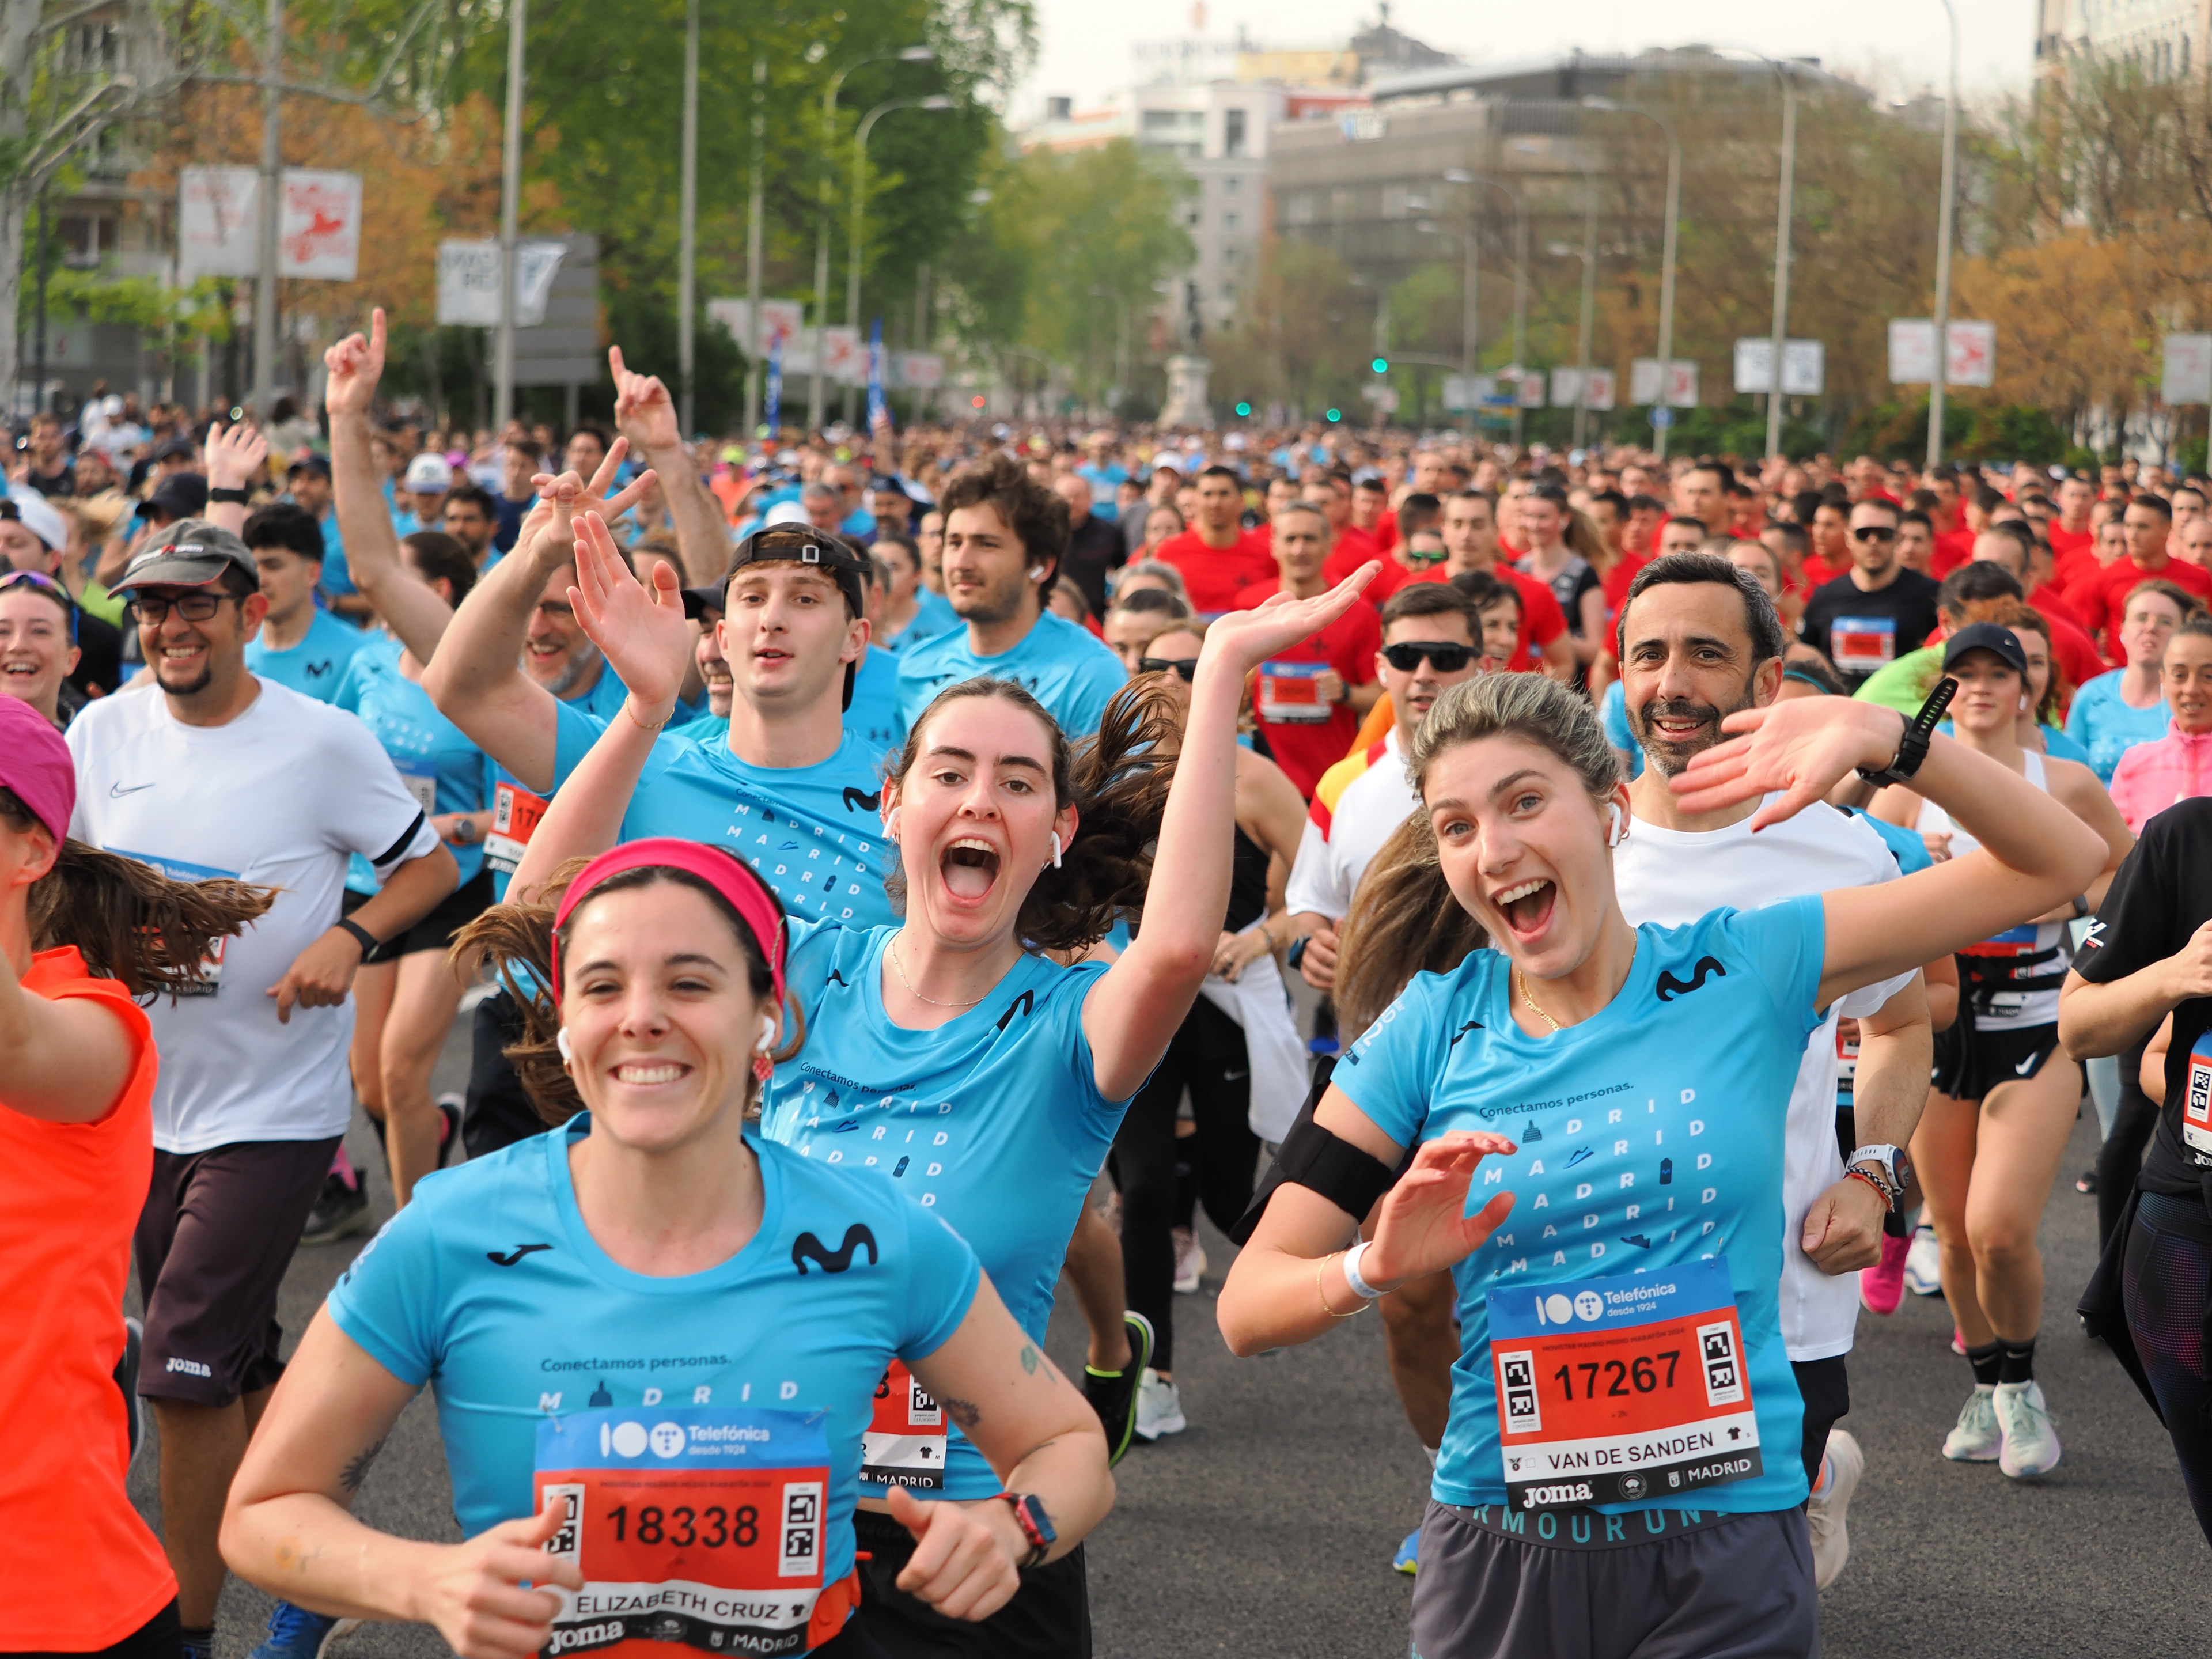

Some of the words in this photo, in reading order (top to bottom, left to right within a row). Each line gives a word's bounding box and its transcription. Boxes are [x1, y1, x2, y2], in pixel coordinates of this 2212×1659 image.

[800, 1062, 859, 1090] Conectamos
[1479, 1099, 1563, 1119] Conectamos
[1567, 1082, 1634, 1107] personas.
[1604, 1283, 1676, 1305] Telefónica
[1607, 1306, 1635, 1317] desde
[1636, 1301, 1657, 1313] 1924
[541, 1357, 646, 1372] Conectamos
[650, 1354, 732, 1372] personas.
[1555, 1350, 1681, 1401] 17267
[688, 1424, 770, 1442] Telefónica
[1548, 1452, 1591, 1469] VAN
[1595, 1449, 1623, 1465] DE
[1628, 1431, 1714, 1462] SANDEN
[877, 1475, 934, 1488] MADRID
[1688, 1458, 1752, 1482] MADRID
[607, 1505, 759, 1548] 18338
[577, 1590, 707, 1614] ELIZABETH
[714, 1600, 780, 1620] CRUZ
[733, 1633, 799, 1653] MADRID
